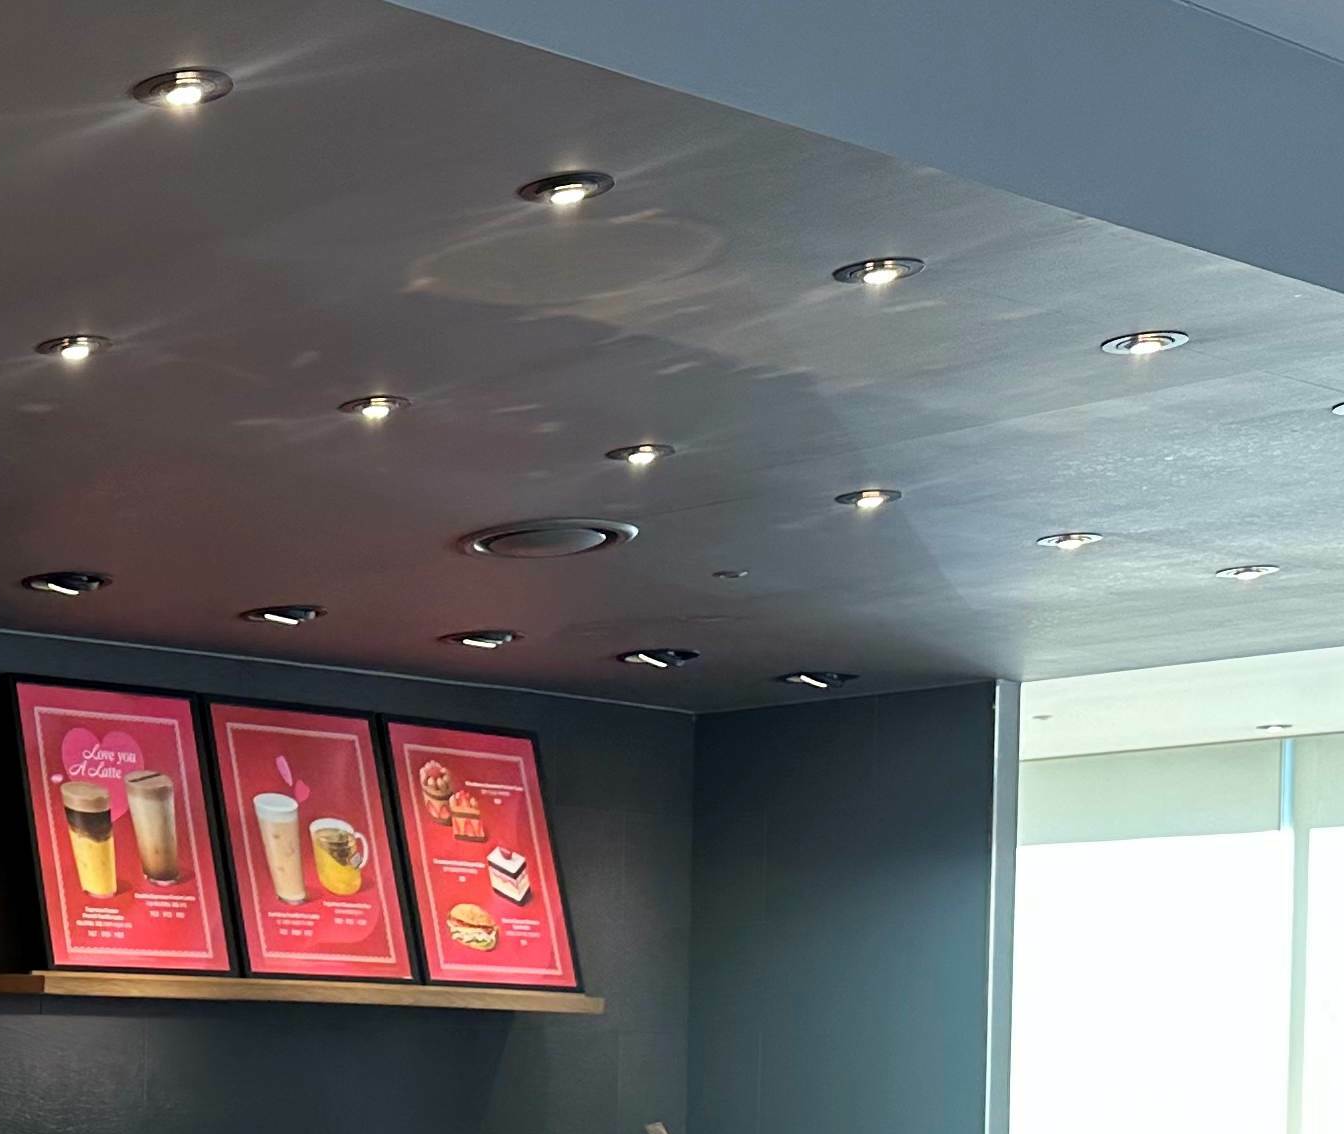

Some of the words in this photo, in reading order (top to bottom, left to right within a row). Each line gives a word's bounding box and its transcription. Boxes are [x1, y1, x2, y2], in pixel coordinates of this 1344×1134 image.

[82, 743, 115, 762] Love
[116, 751, 137, 765] you
[87, 761, 122, 779] Latte
